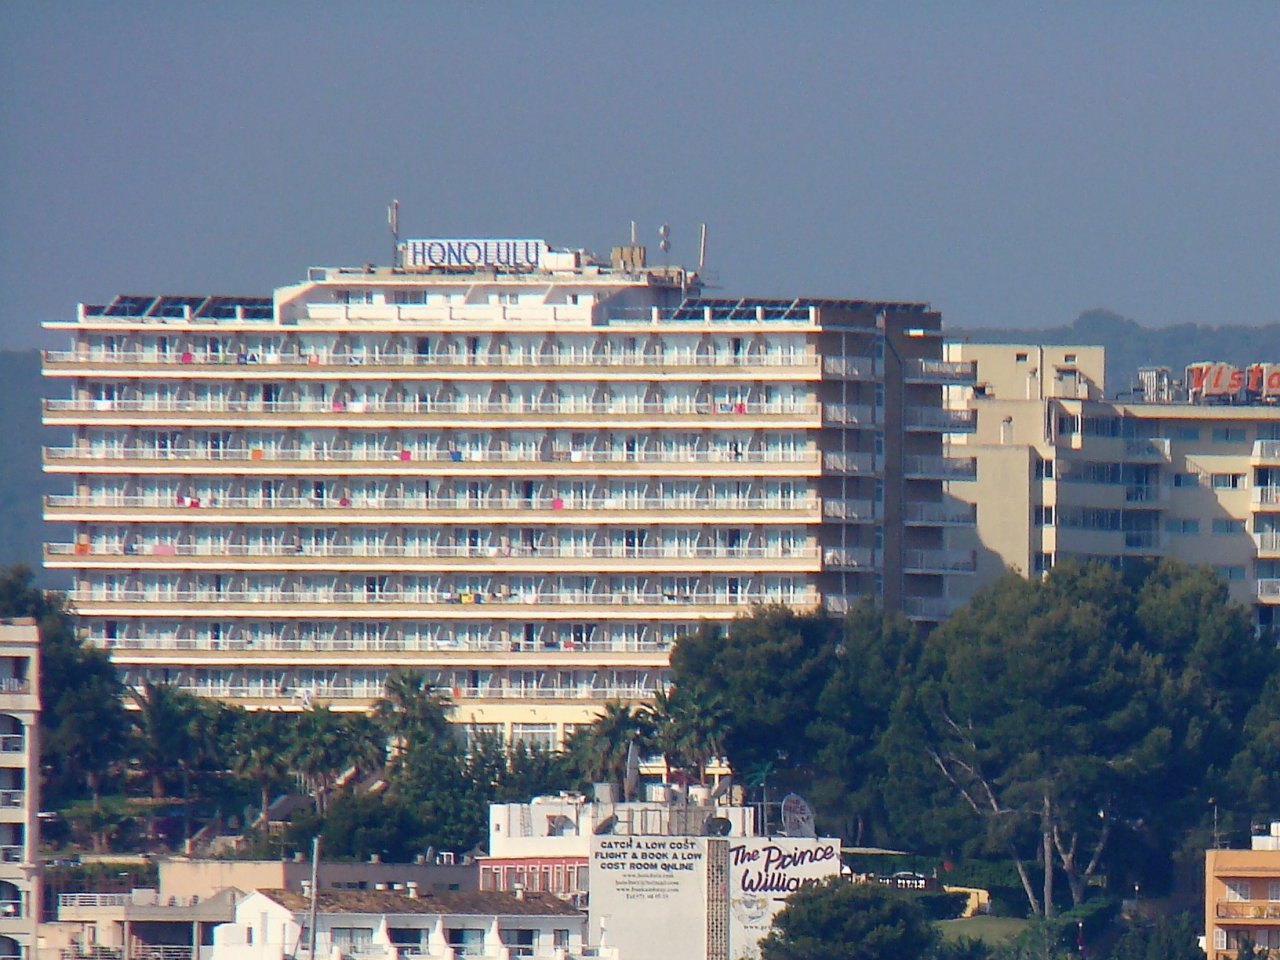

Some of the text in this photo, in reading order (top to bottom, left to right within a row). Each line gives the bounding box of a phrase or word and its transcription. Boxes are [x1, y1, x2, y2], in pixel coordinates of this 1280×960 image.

[411, 241, 539, 266] HONOLULU
[600, 841, 696, 849] CATCH A LOW COST
[594, 852, 702, 860] FLIGHT & BOOK A LOW
[729, 845, 835, 873] The Prince
[600, 862, 627, 870] COST
[660, 863, 694, 871] ONLINE
